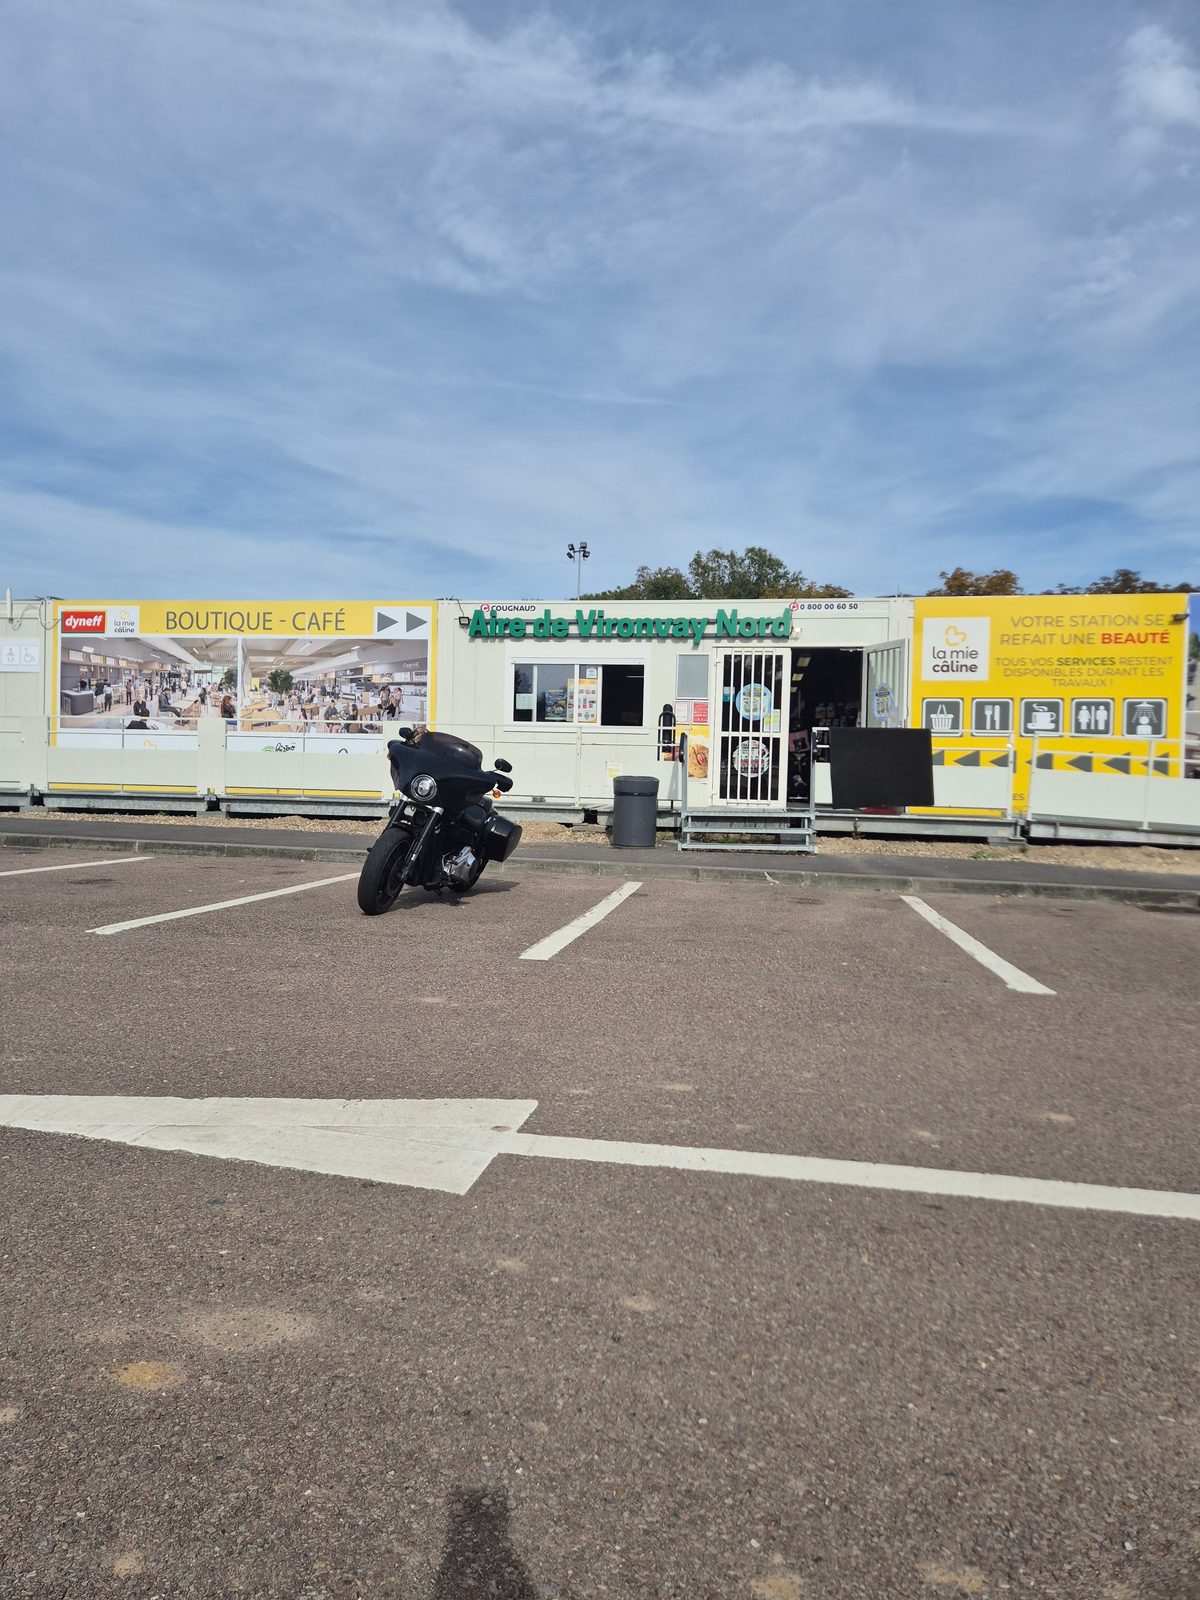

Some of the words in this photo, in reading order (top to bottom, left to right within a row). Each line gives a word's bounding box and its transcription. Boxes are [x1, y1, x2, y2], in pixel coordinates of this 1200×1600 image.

[491, 604, 536, 612] COUGNAUD
[65, 614, 103, 629] dyneff
[166, 611, 273, 632] BOUTIQUE
[292, 608, 346, 631] CAFÉ
[469, 609, 526, 637] Aire
[533, 609, 570, 637] de
[576, 609, 708, 644] Vironvay
[716, 608, 792, 638] Nord
[1010, 615, 1066, 628] VOTRE
[1070, 614, 1139, 627] STATION
[1144, 614, 1165, 626] SE
[1000, 633, 1057, 646] REFAIT
[1060, 632, 1096, 645] UNE
[1101, 629, 1171, 645] BEAUTÉ
[932, 646, 947, 659] la
[950, 646, 979, 659] mie
[932, 659, 978, 673] câline
[995, 657, 1027, 667] TOUS
[1030, 657, 1055, 667] VOS
[1057, 657, 1116, 667] SERVICES
[1119, 656, 1174, 666] RESTENT
[1003, 667, 1084, 677] DISPONIBLES
[1087, 667, 1138, 677] DURANT
[1142, 667, 1164, 677] LES
[1052, 678, 1108, 688] TRAVAUX
